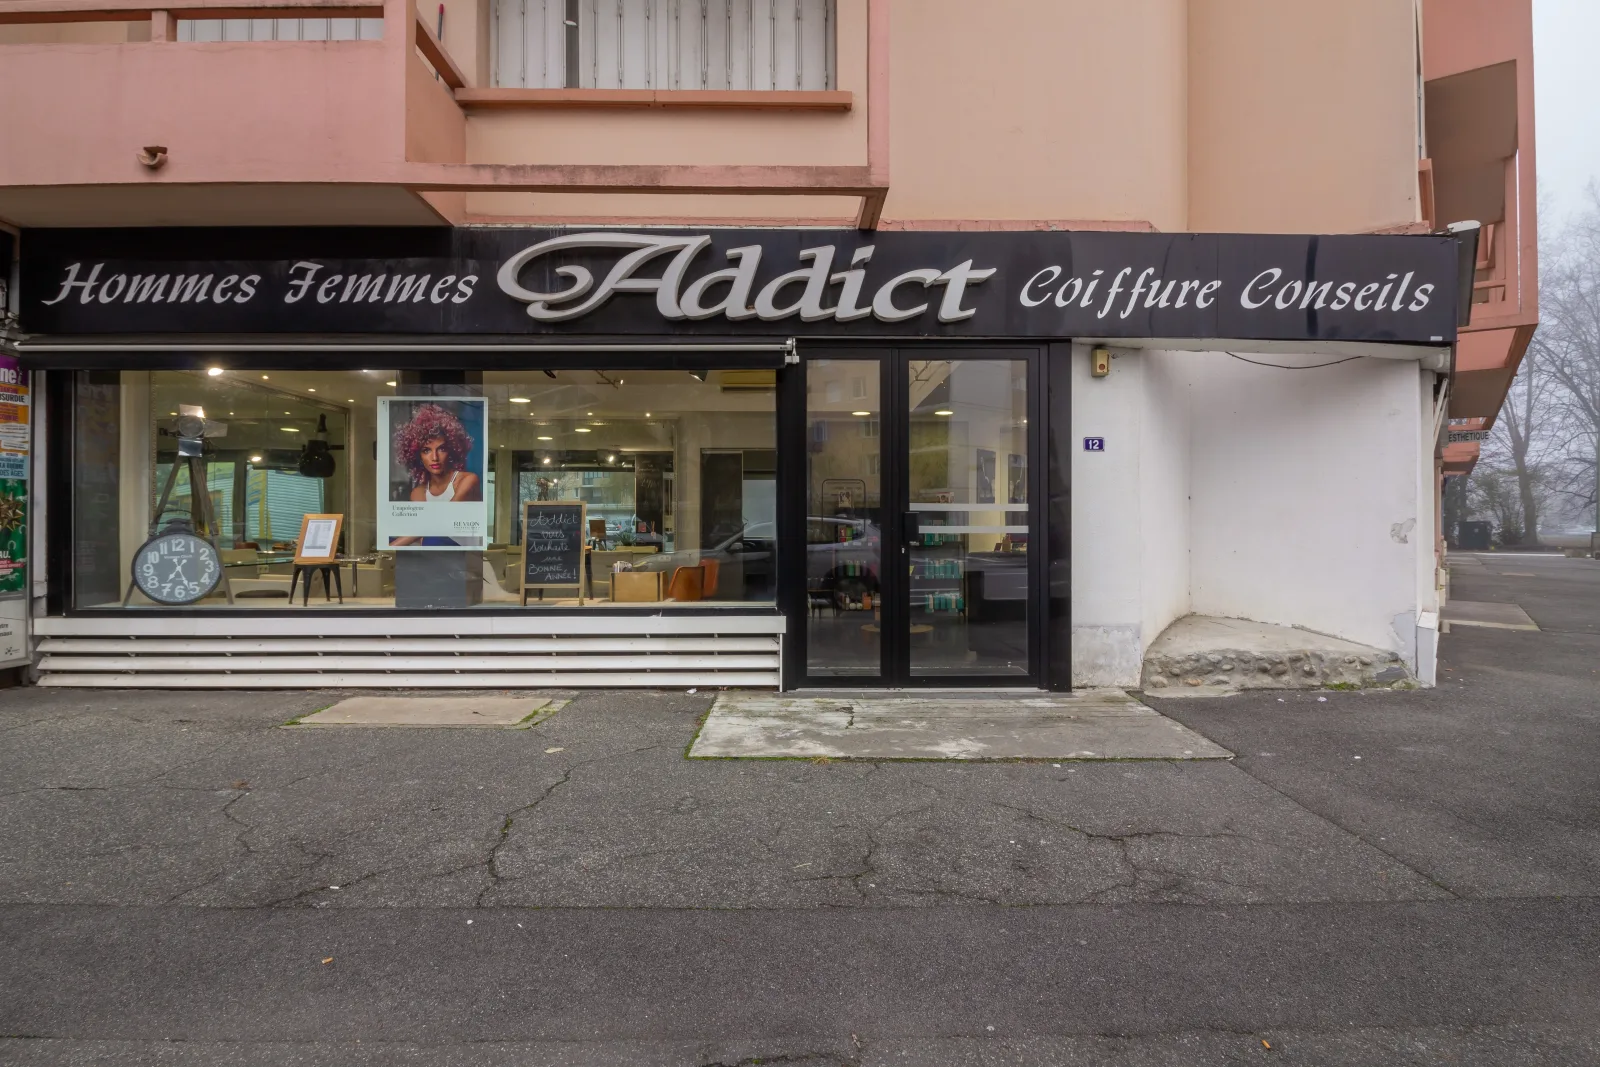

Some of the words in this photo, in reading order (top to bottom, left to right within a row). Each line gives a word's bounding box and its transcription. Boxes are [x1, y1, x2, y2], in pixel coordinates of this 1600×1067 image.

[41, 262, 262, 305] Hommes
[284, 261, 479, 305] Femmes
[496, 231, 998, 322] Addict
[1019, 265, 1222, 319] Coiffure
[1240, 267, 1435, 312] Conseils
[1448, 431, 1489, 442] ESTHETIQUE
[1088, 439, 1100, 450] 12
[159, 541, 168, 555] 11
[171, 538, 186, 552] 12
[189, 540, 195, 553] 1
[147, 551, 160, 564] 10
[199, 548, 210, 561] 2
[142, 563, 154, 577] 9
[204, 560, 214, 573] 3
[147, 575, 160, 589] 8
[200, 572, 211, 585] 4
[161, 582, 173, 597] 7
[174, 585, 185, 598] 6
[188, 581, 200, 594] 5
